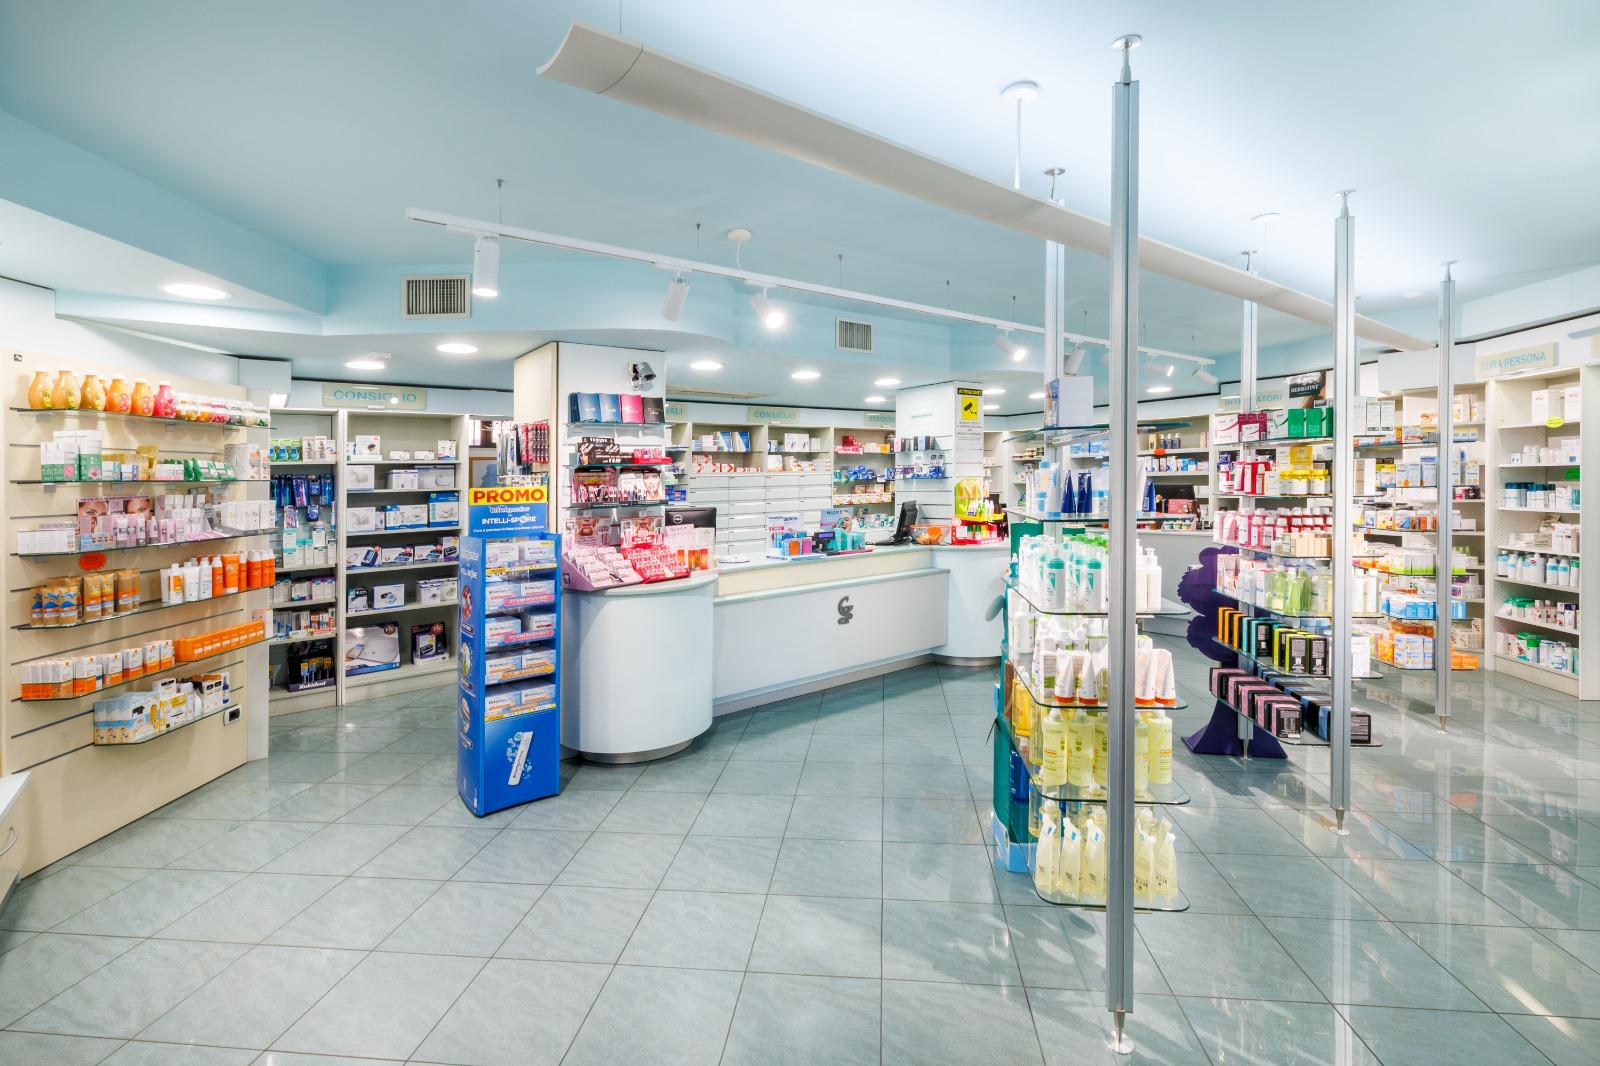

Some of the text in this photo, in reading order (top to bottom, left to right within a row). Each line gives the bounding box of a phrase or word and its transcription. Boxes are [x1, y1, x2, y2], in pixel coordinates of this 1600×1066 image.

[1504, 351, 1546, 368] PERSONA
[1291, 384, 1318, 393] HERBATINT
[473, 488, 544, 503] PROMO
